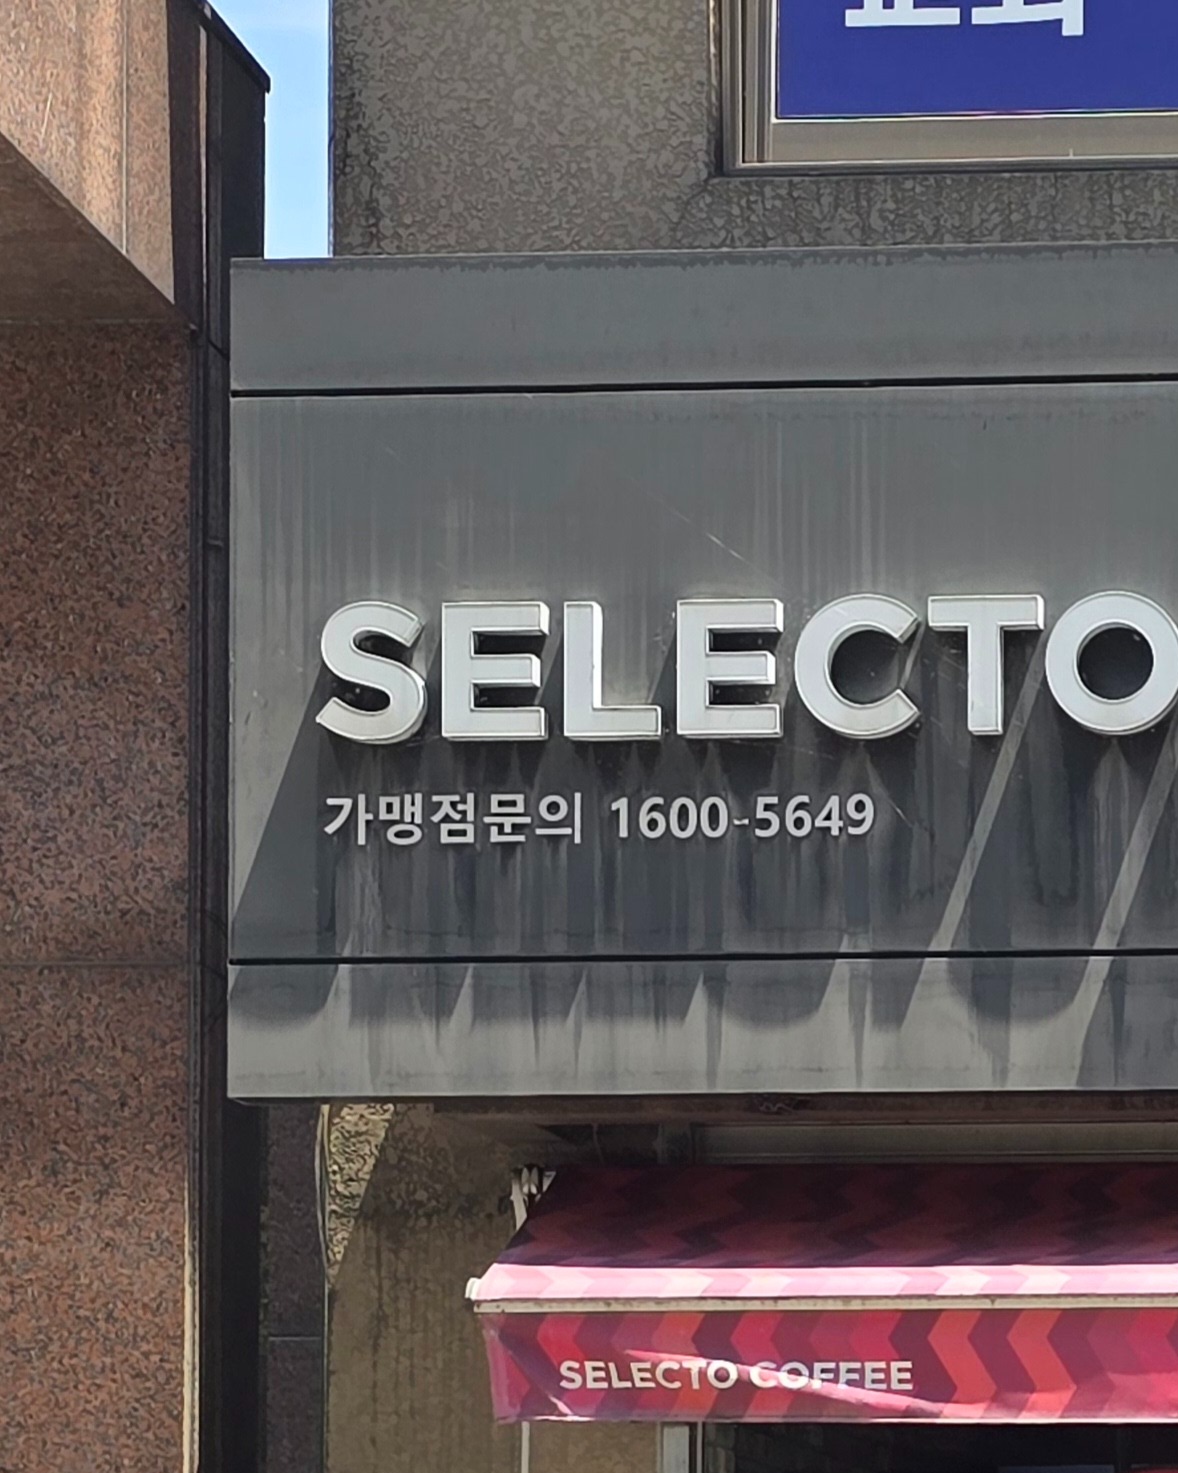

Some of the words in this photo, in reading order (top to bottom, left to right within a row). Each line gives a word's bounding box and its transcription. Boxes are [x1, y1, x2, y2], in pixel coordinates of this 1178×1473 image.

[323, 789, 583, 846] 가맹점문의
[610, 794, 875, 840] 1600-5649
[559, 1360, 738, 1390] SELECTO
[749, 1360, 913, 1390] COFFEE
